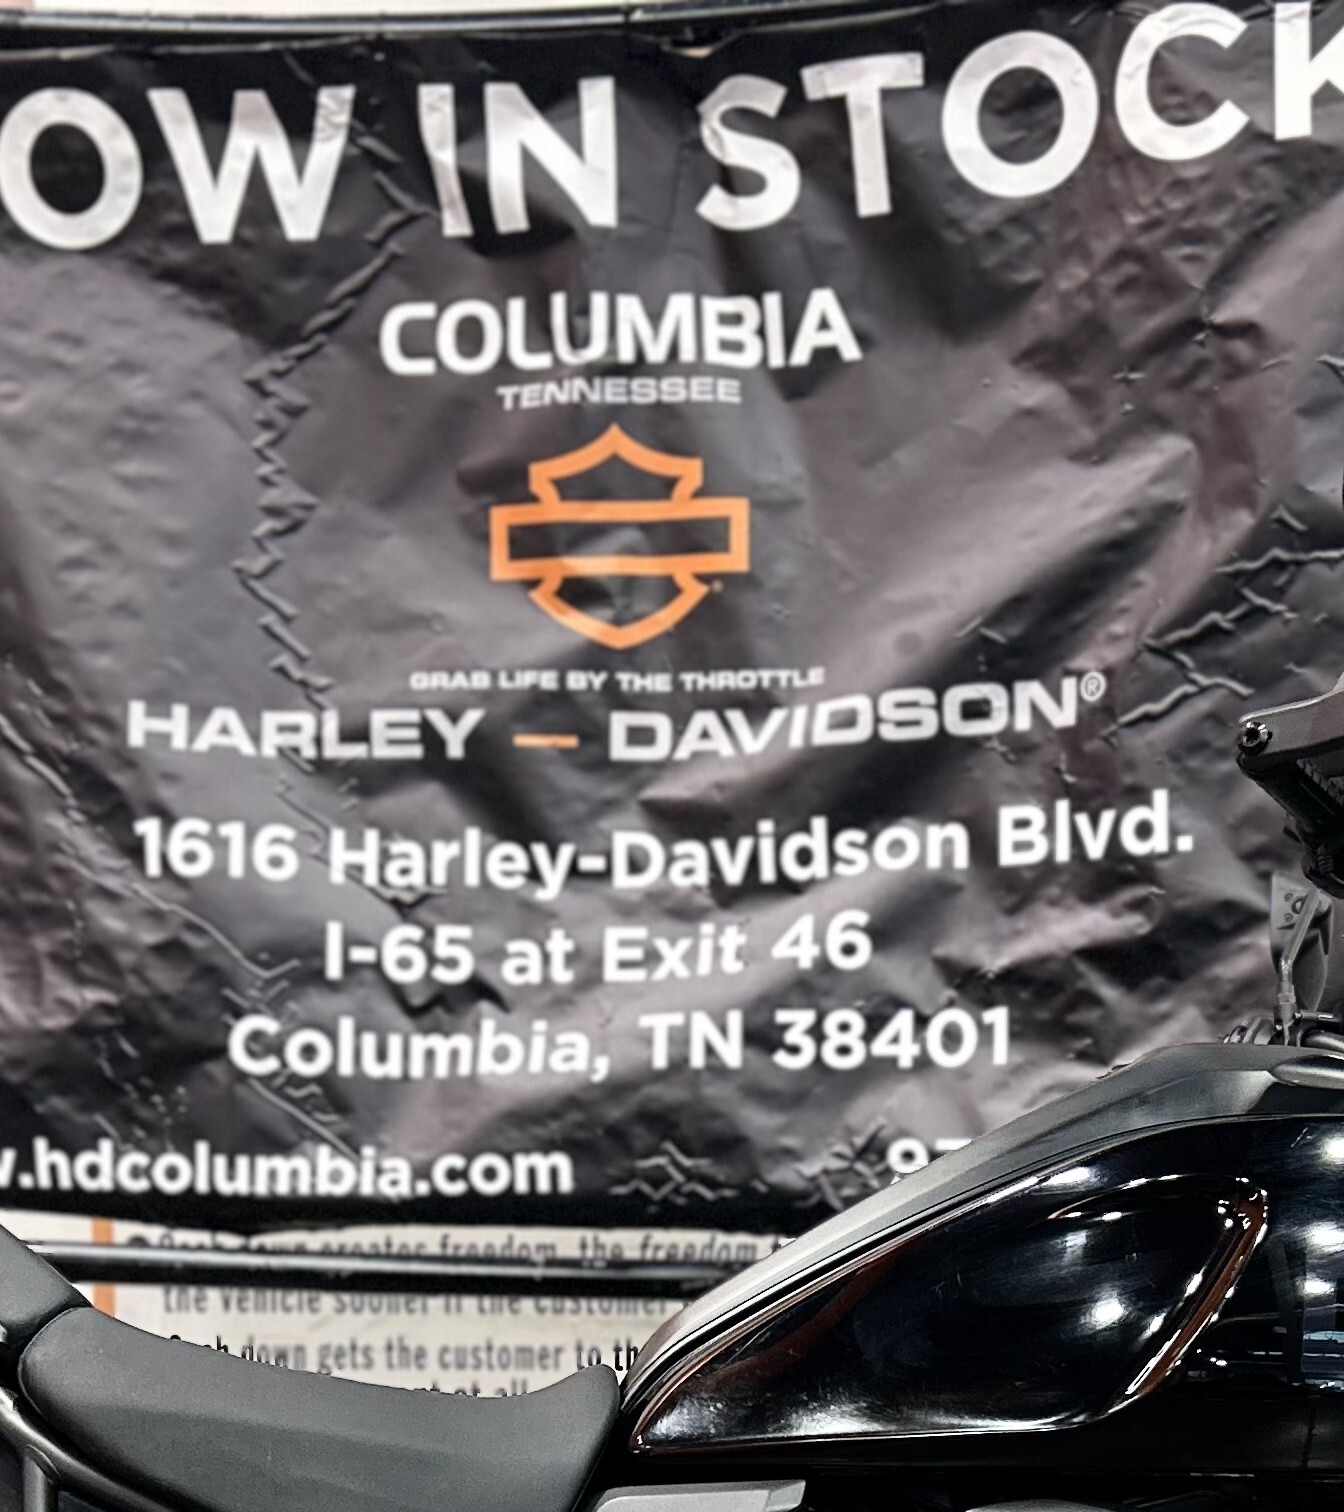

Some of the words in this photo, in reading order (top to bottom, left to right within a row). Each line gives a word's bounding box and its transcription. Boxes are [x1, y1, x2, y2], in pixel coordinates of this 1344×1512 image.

[419, 77, 619, 237] IN
[380, 288, 863, 376] COLUMBIA
[496, 376, 743, 411] TENNESSEE
[409, 670, 491, 692] GRAB
[498, 670, 558, 690] LIFE
[566, 670, 607, 691] BY
[616, 672, 672, 693] THE
[680, 666, 826, 692] THROTTLE
[127, 699, 485, 760] HARLEY
[134, 818, 300, 881] 1616
[328, 817, 969, 901] Harley-Davidson
[998, 788, 1195, 867] Blvd.
[326, 921, 475, 983] I-65
[501, 928, 575, 985] at
[602, 921, 748, 984] Exit
[771, 909, 872, 970] 46
[229, 1015, 611, 1083] Columbia,
[637, 1009, 743, 1069] TN
[772, 1007, 1009, 1070] 38401
[332, 1291, 429, 1315] sooner
[533, 1297, 669, 1317] customer
[316, 1342, 376, 1376] gets
[387, 1335, 429, 1372] the
[438, 1342, 563, 1373] customer
